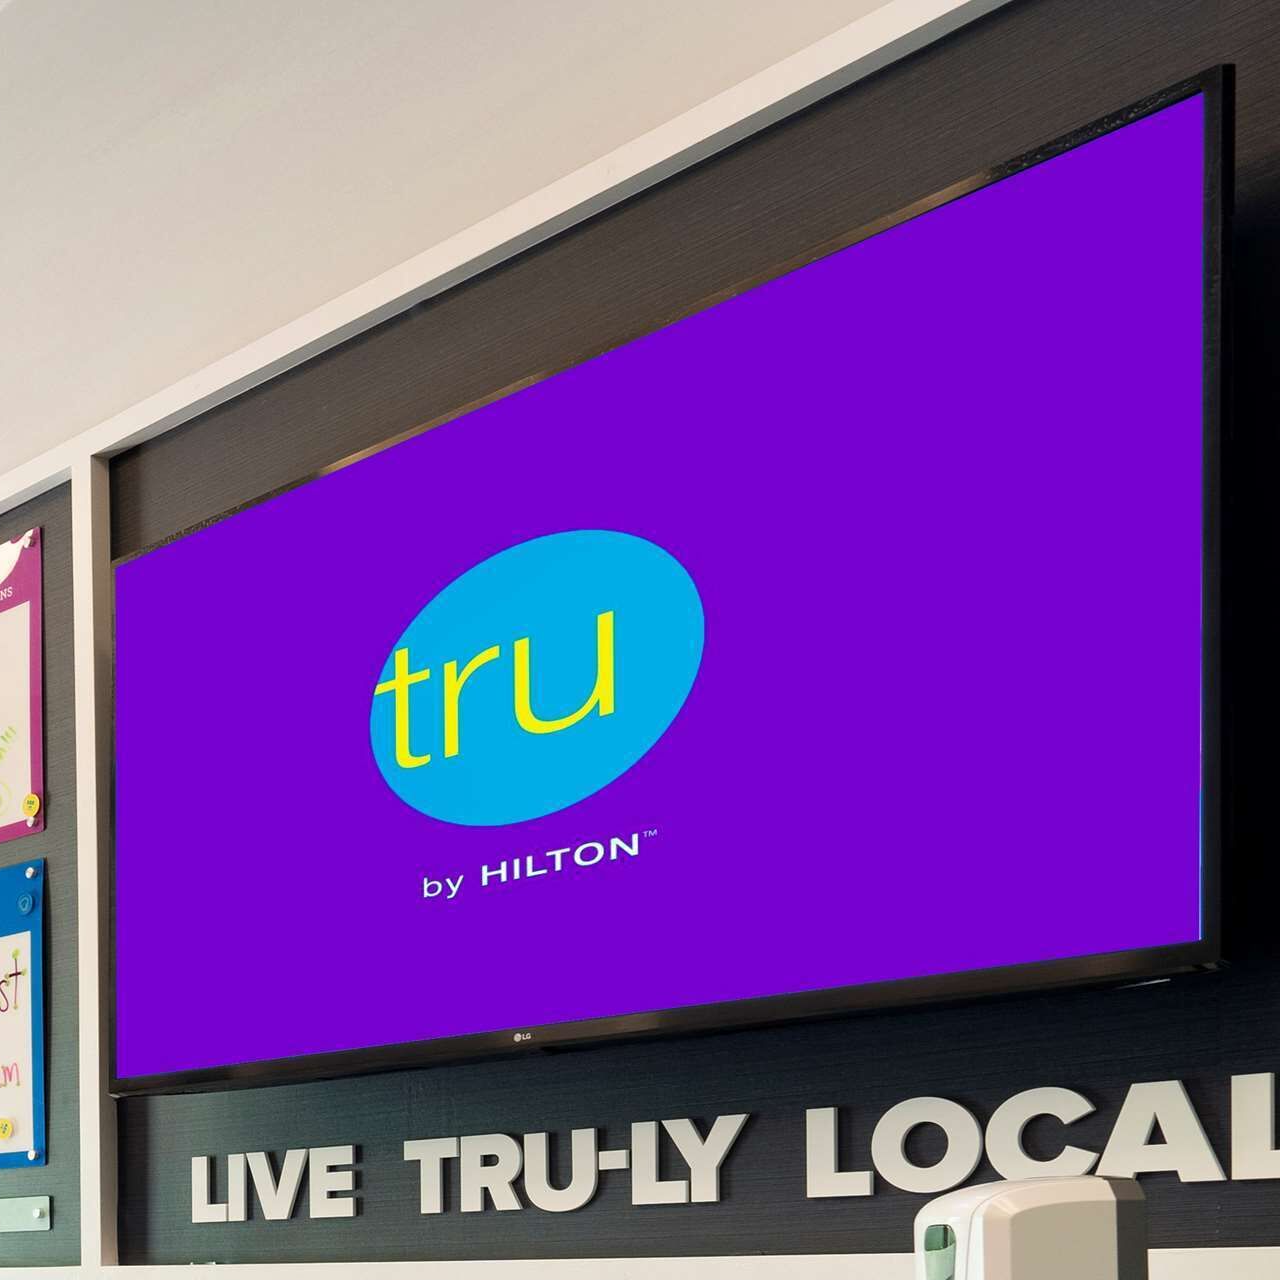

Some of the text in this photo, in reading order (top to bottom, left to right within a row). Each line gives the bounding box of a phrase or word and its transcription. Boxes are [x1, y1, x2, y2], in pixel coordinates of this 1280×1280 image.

[374, 610, 615, 769] tru
[422, 874, 464, 899] by
[191, 1072, 1280, 1223] LIVE TRU-LY LOCAL
